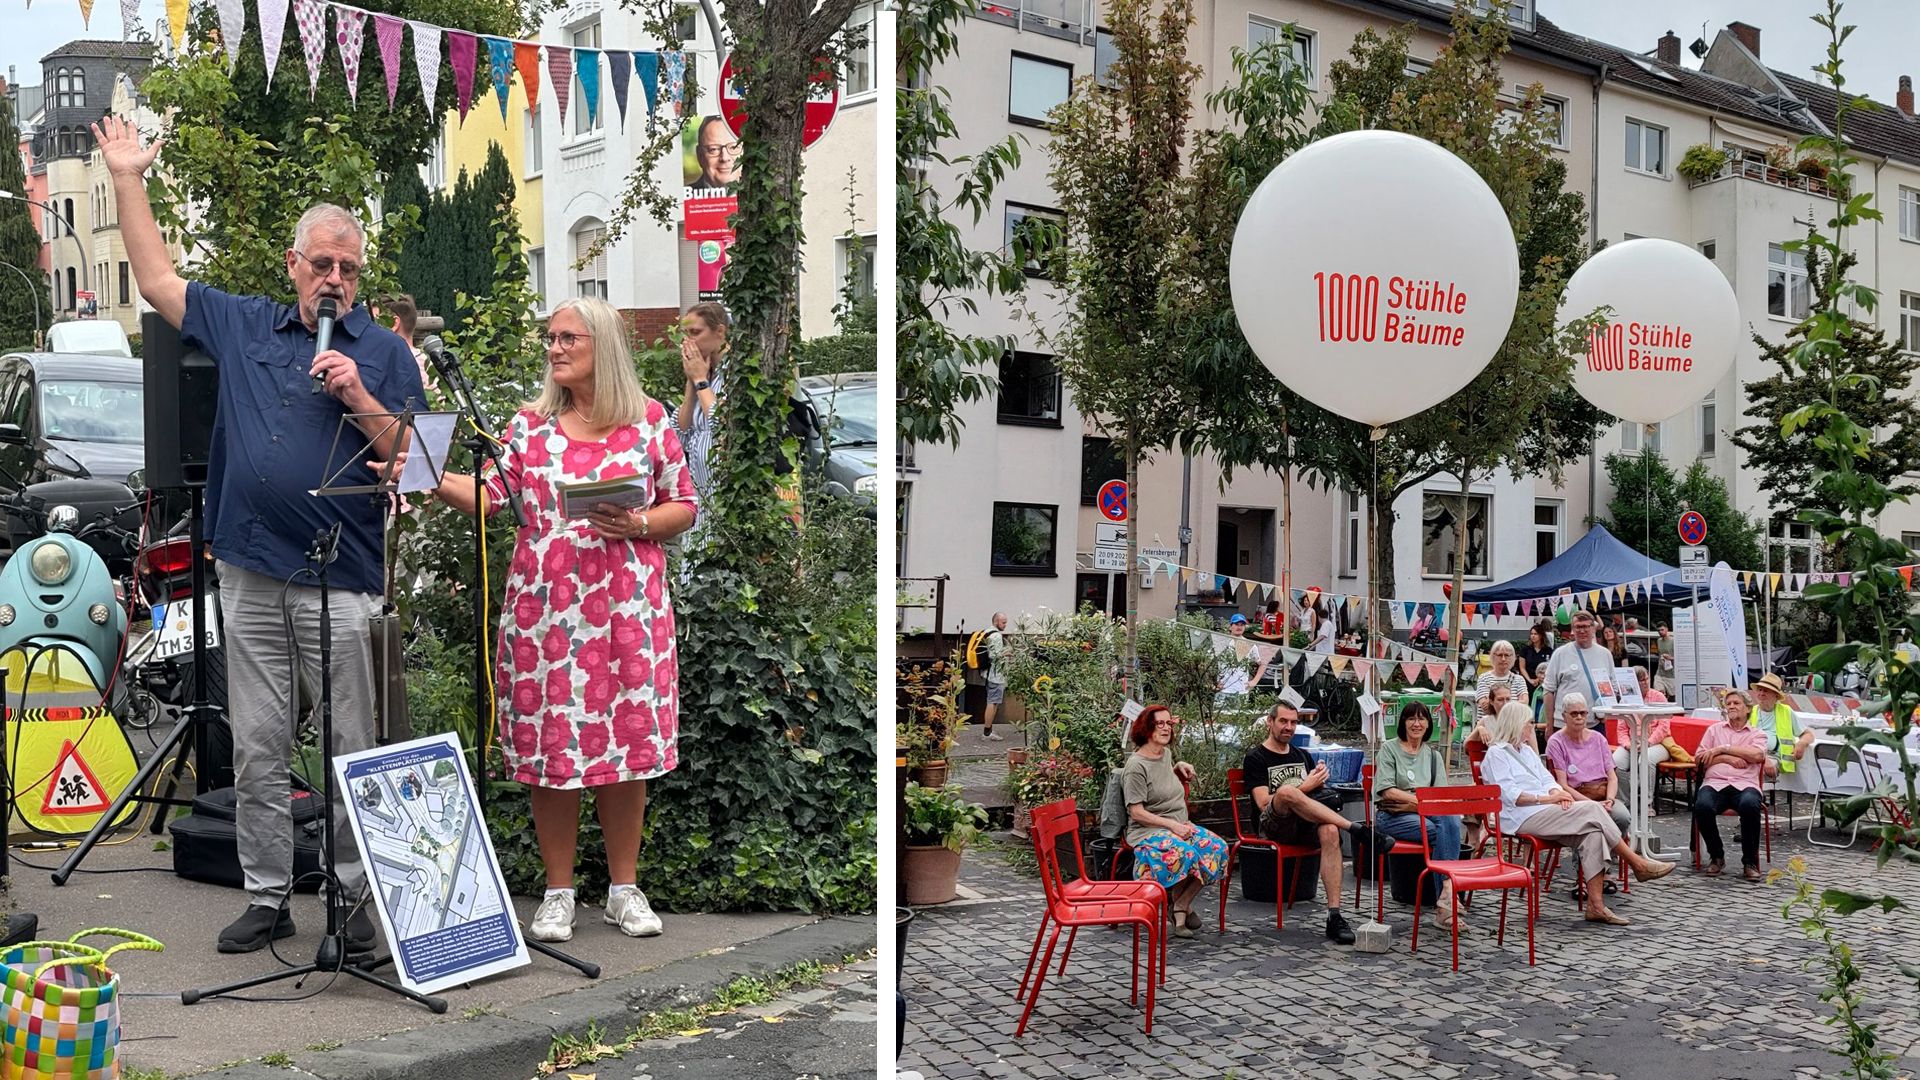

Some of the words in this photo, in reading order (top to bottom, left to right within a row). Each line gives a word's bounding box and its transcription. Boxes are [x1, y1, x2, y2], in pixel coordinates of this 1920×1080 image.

[1314, 272, 1379, 342] 1000
[1388, 277, 1467, 314] Stühle
[1384, 313, 1465, 346] Bäume
[1629, 322, 1692, 349] Stühle
[1629, 349, 1693, 372] Bäume
[1142, 547, 1179, 558] Petersbergstr.
[177, 601, 188, 617] K
